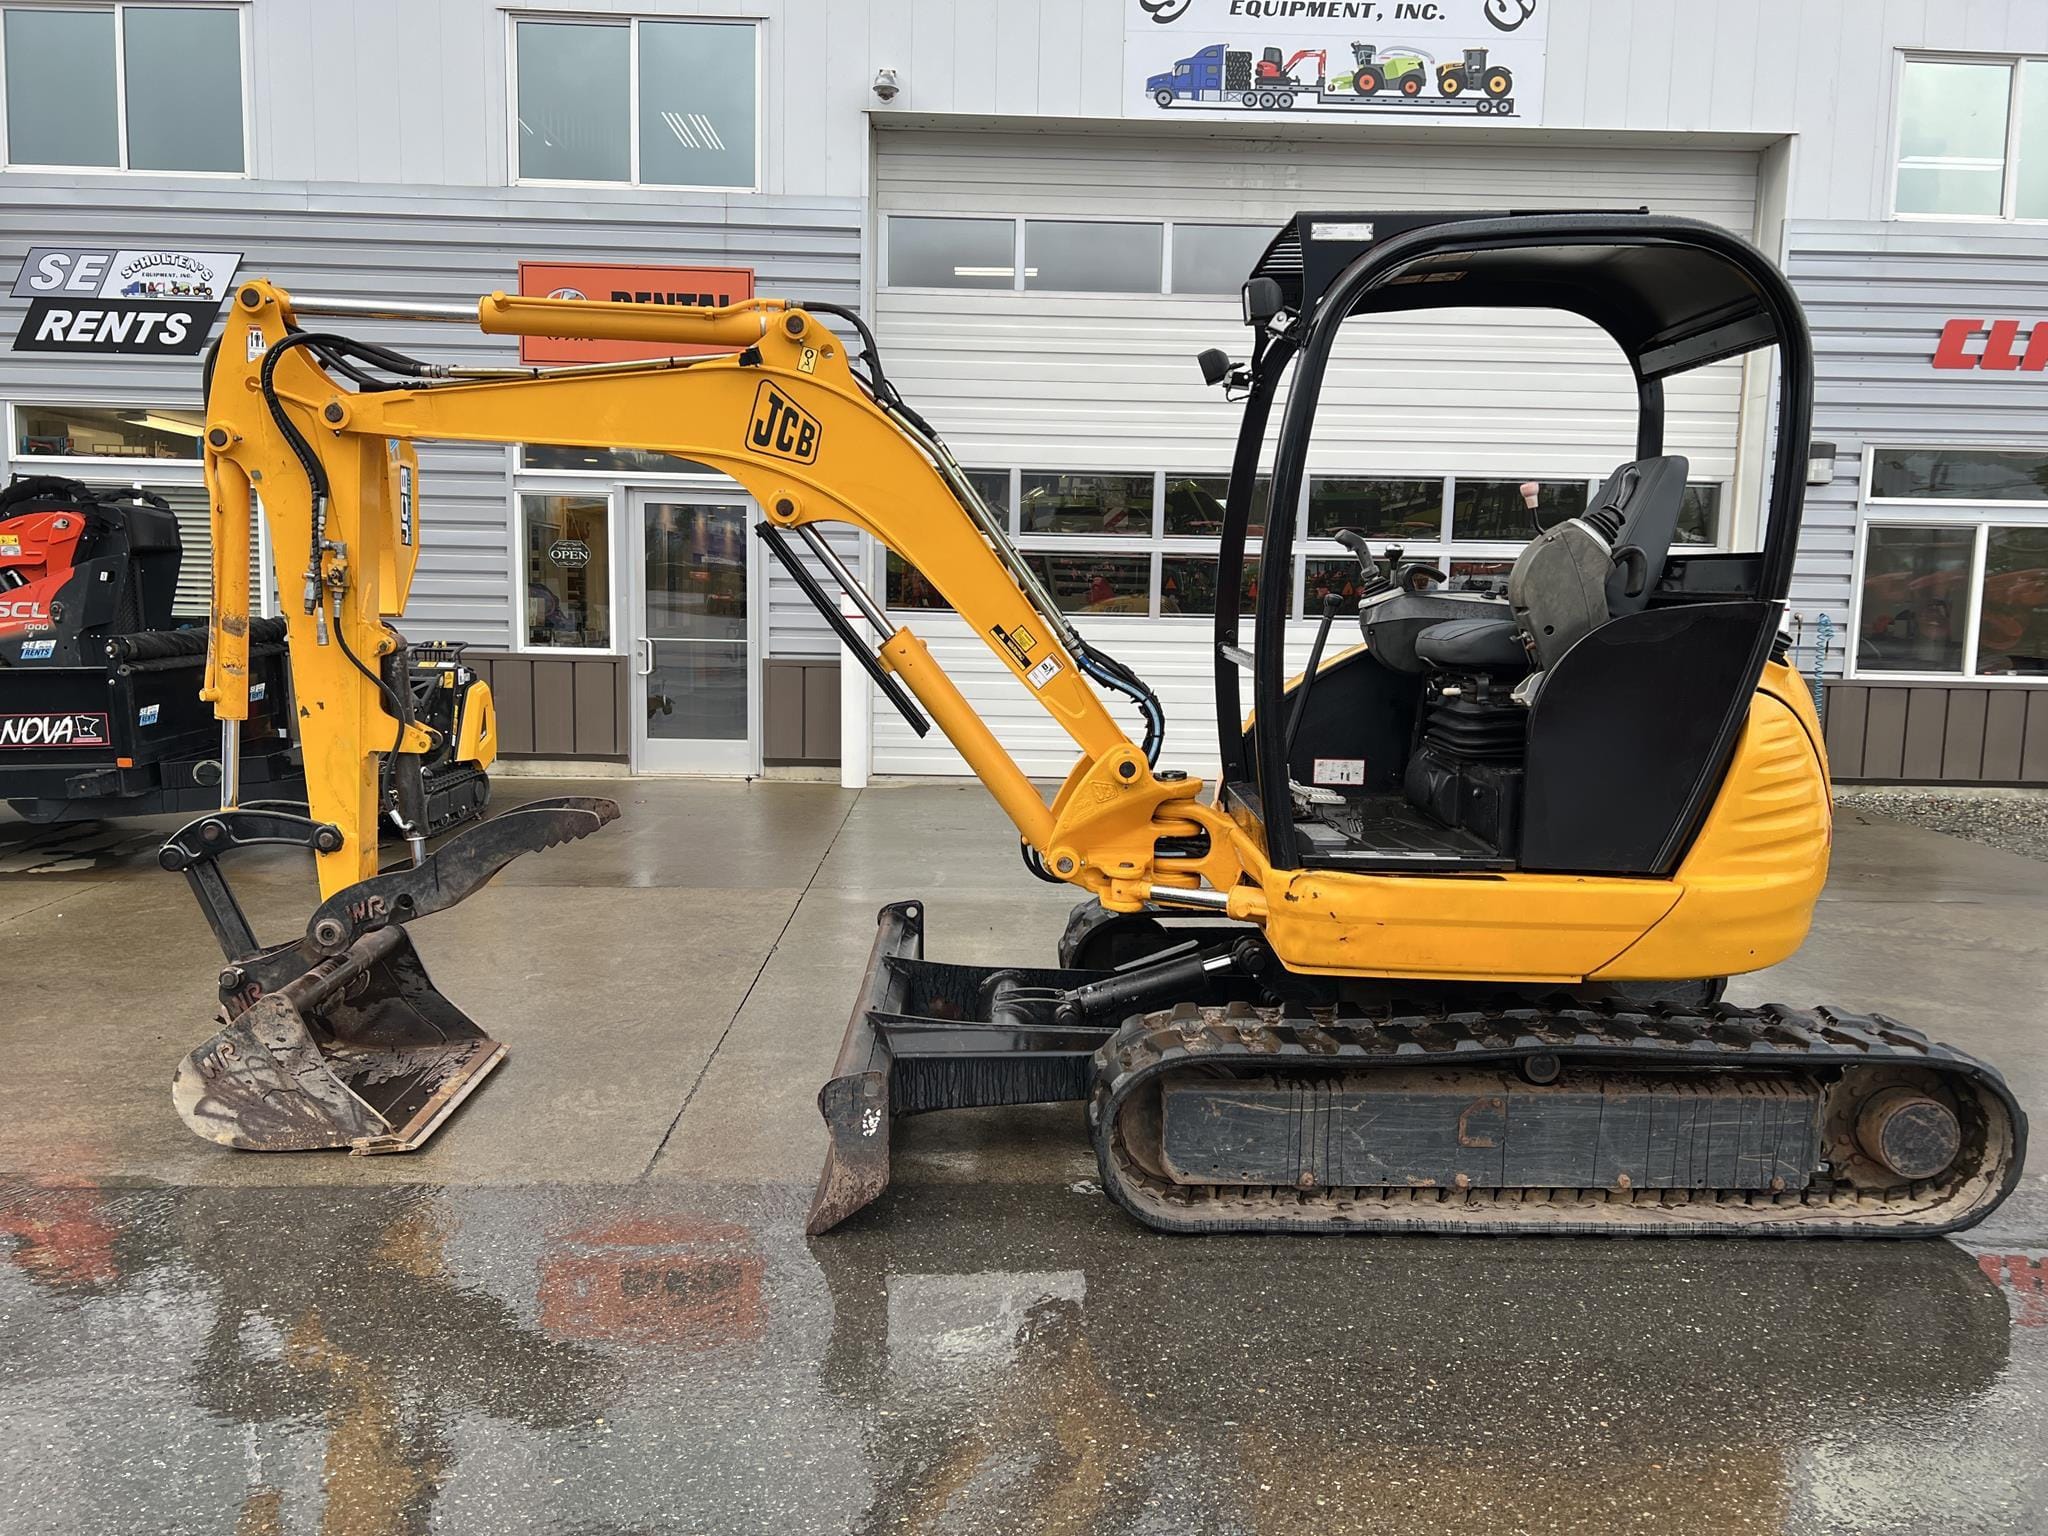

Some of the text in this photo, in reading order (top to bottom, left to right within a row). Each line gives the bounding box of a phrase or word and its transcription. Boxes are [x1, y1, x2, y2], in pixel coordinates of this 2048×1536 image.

[1229, 0, 1446, 21] EQUIPMENT, INC.
[29, 253, 109, 291] SE
[121, 253, 213, 281] SCHOLTEN'S
[35, 309, 193, 345] RENTS
[753, 391, 815, 457] JCB
[551, 550, 588, 560] OPEN
